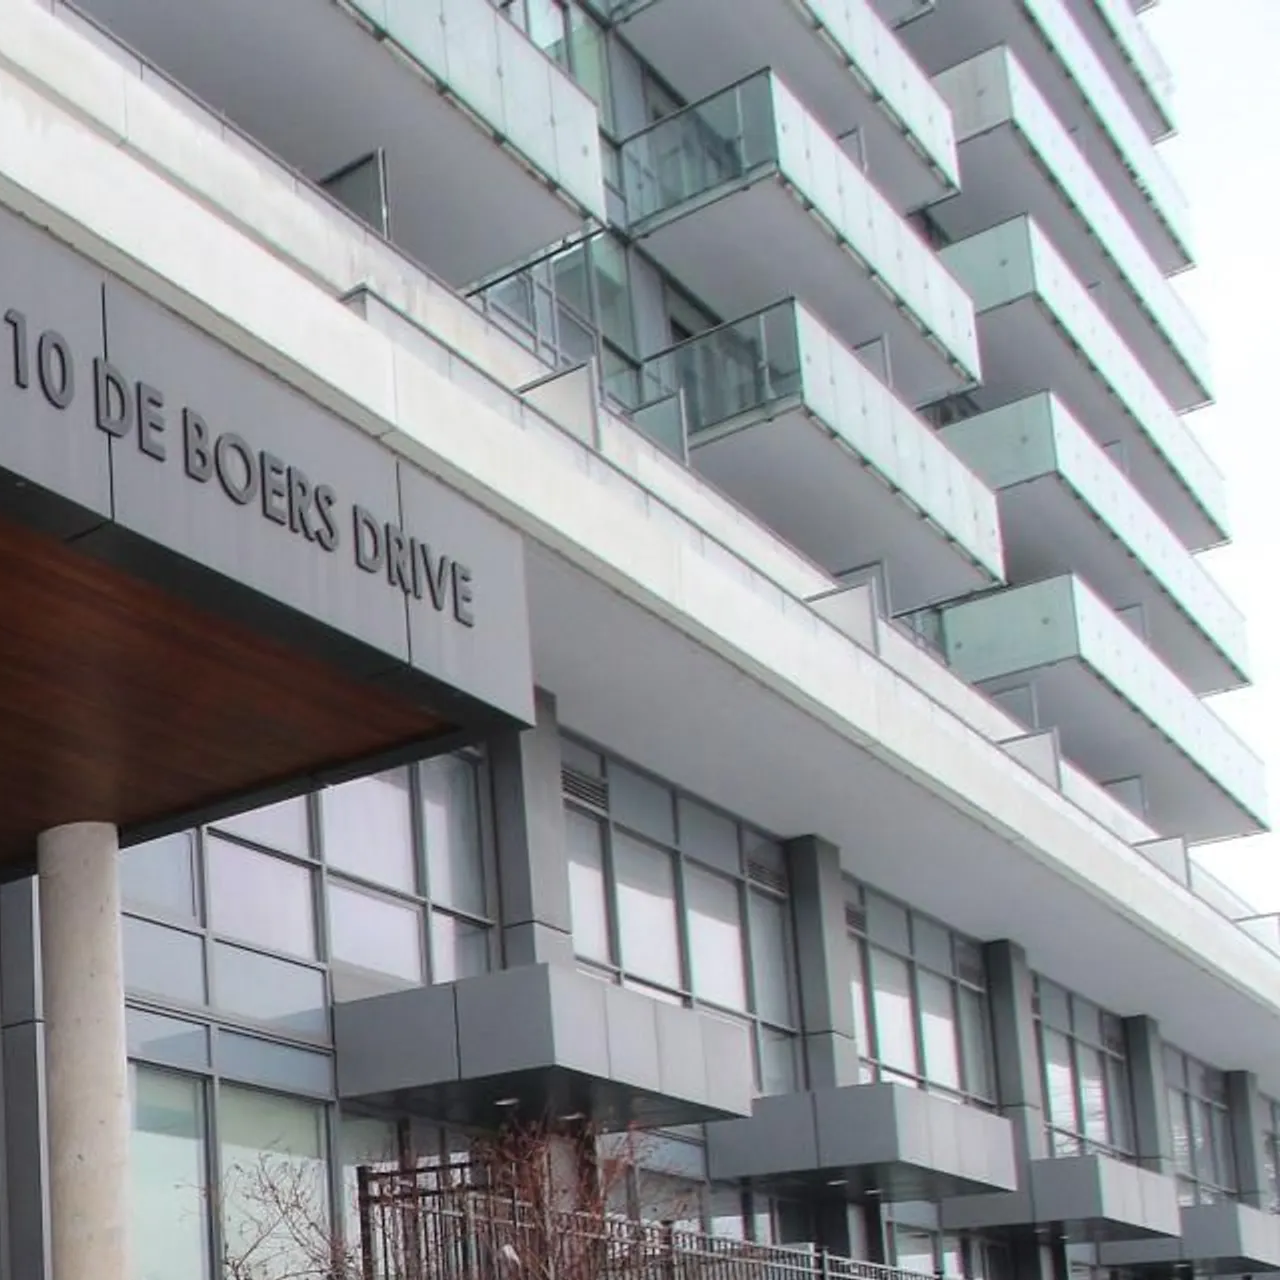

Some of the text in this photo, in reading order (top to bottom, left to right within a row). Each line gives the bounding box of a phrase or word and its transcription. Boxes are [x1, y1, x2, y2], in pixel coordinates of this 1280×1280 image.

[4, 308, 476, 628] 10 DE BOERS DRIVE
